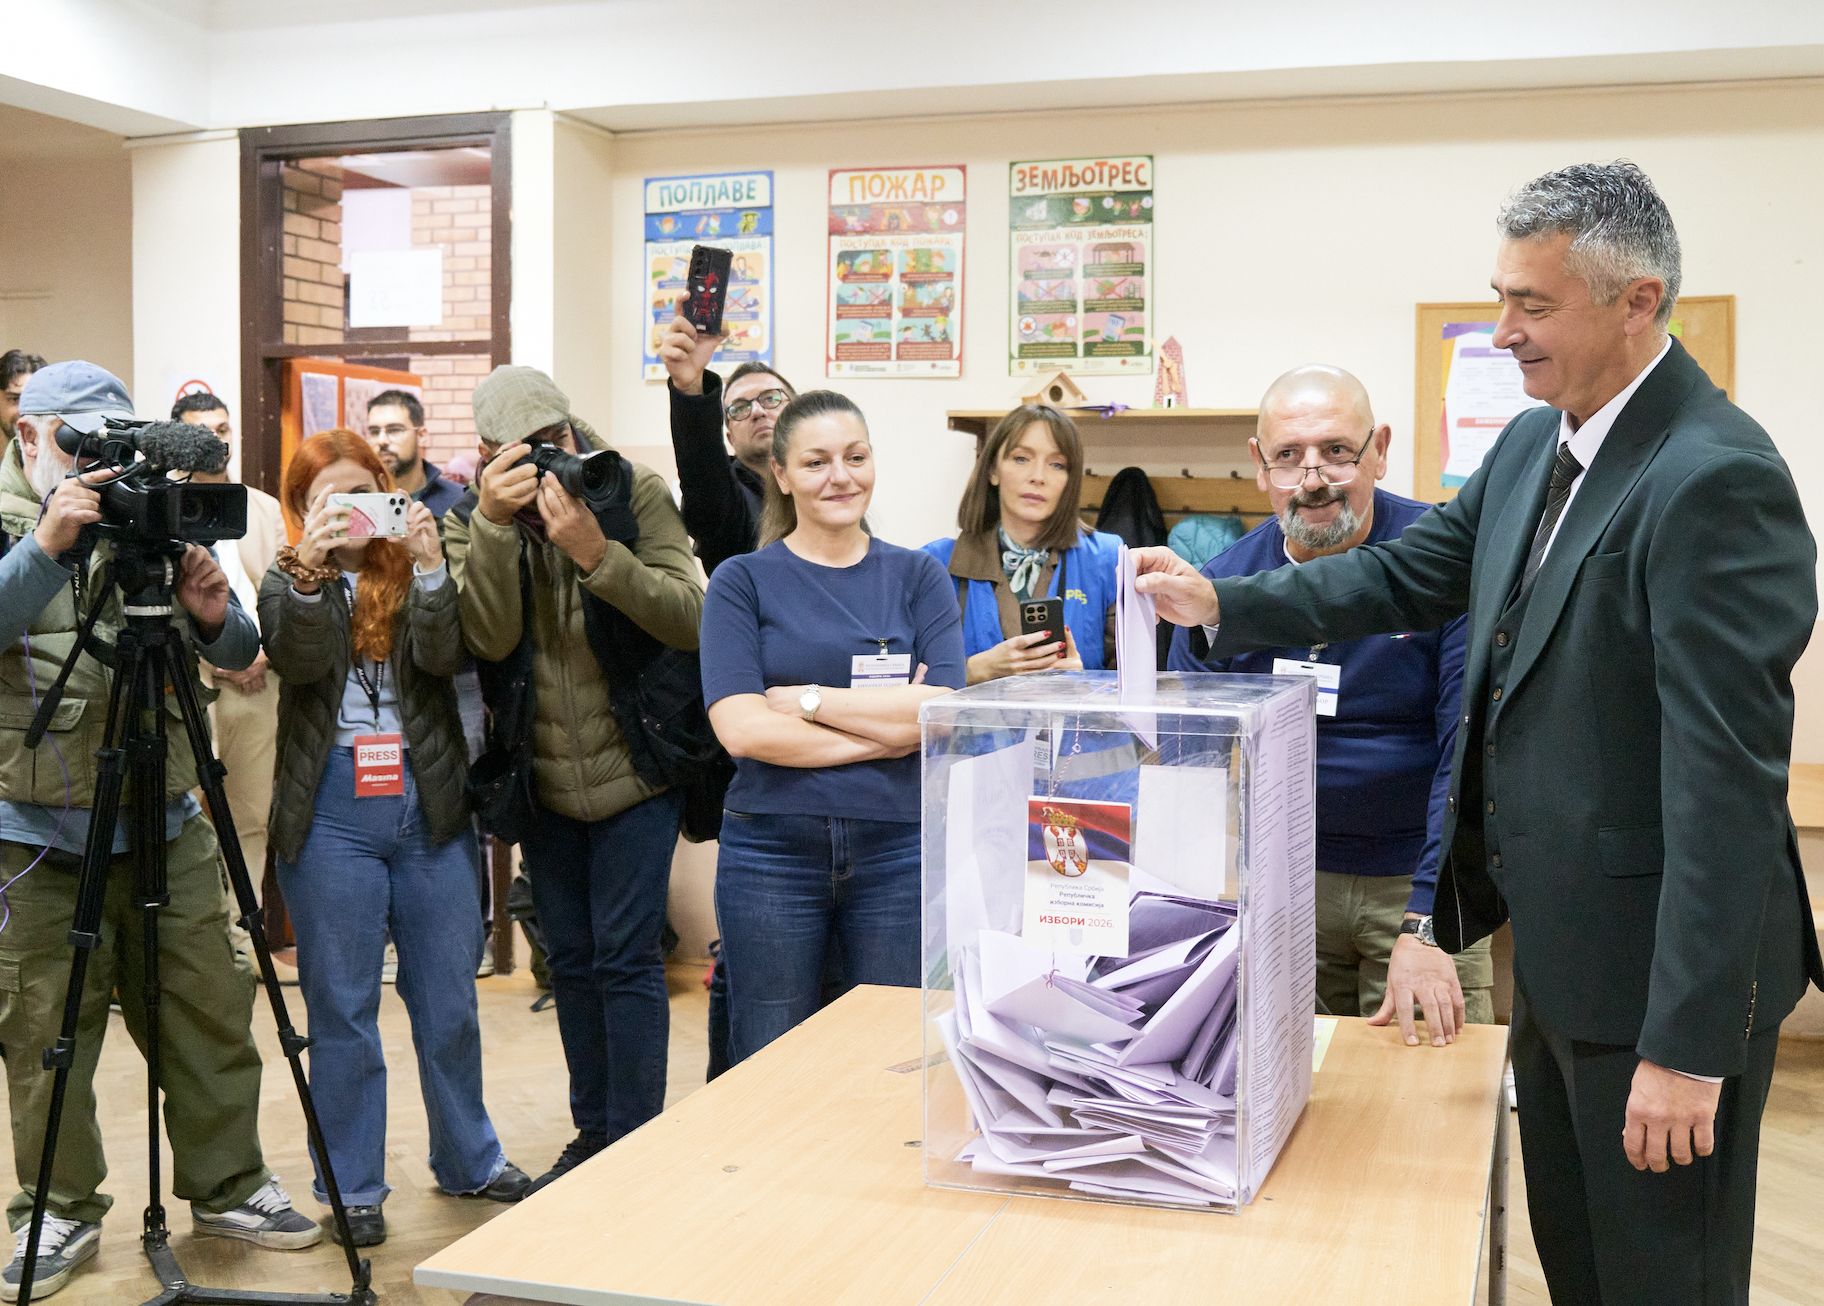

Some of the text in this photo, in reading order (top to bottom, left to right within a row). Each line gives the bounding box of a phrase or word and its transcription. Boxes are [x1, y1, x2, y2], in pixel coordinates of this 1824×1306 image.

[849, 171, 945, 202] ПОЖАР
[1016, 161, 1148, 192] ЗЕМЉОТРЕС
[660, 180, 756, 207] ПОПЛАВЕ
[360, 750, 398, 761] PRESS
[1039, 915, 1115, 928] ИЗБОРИ 2026.
